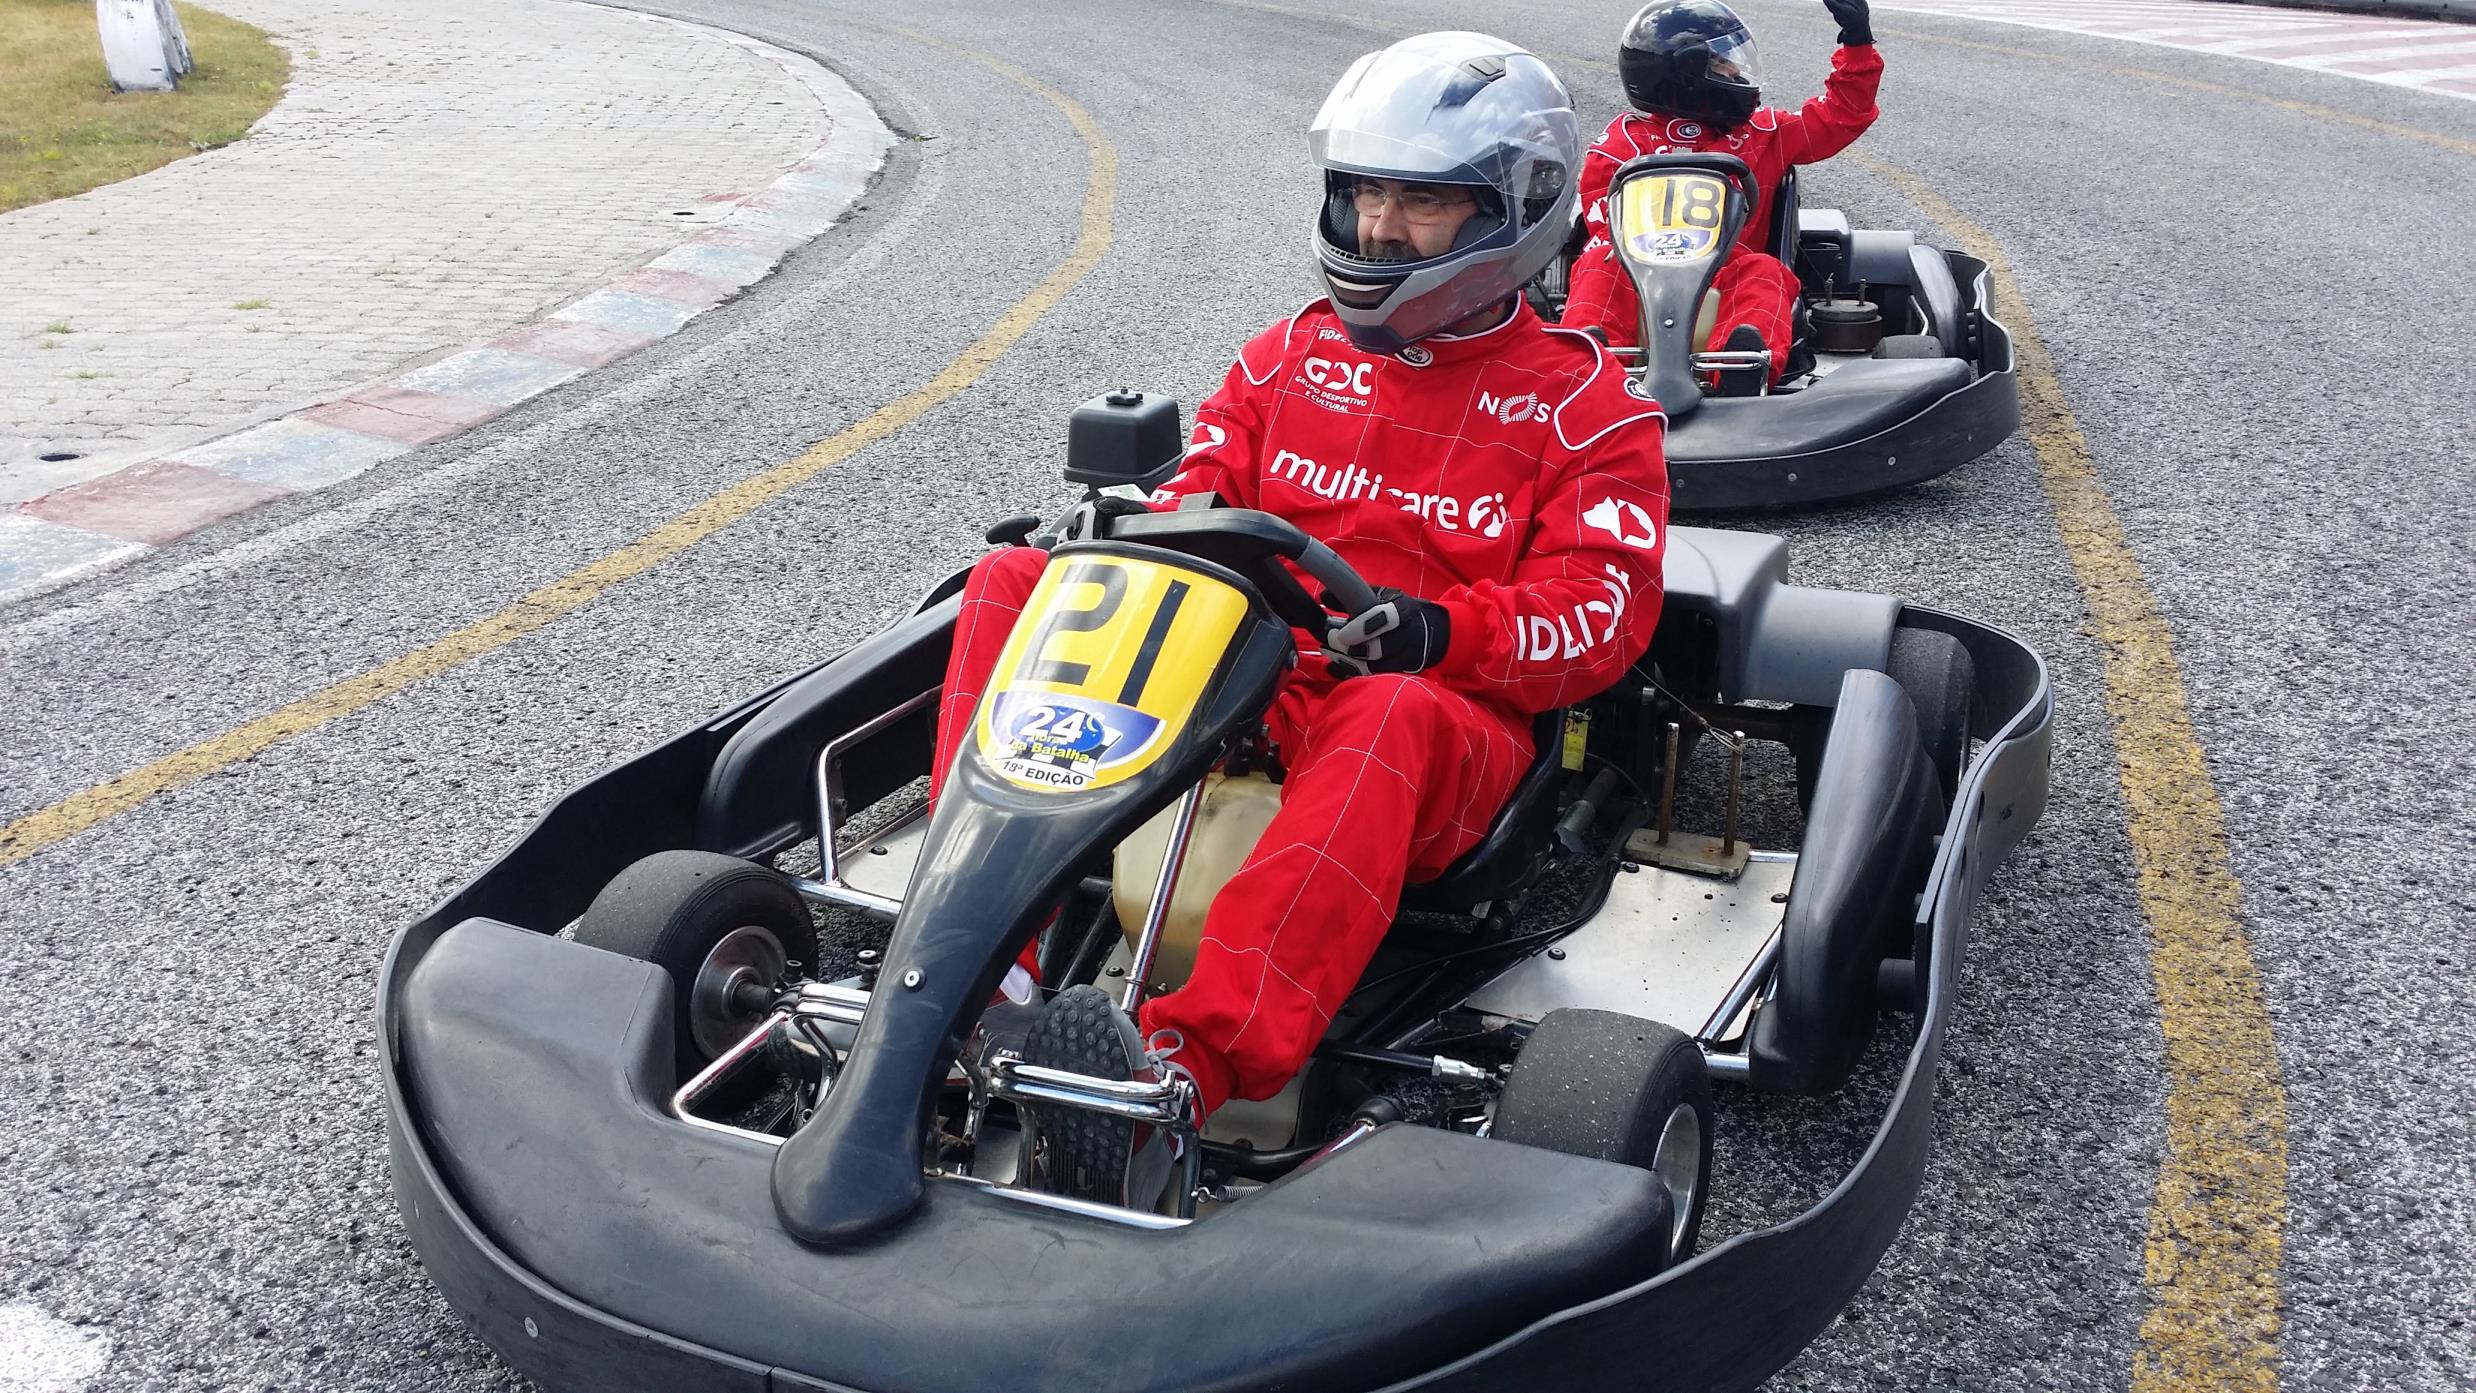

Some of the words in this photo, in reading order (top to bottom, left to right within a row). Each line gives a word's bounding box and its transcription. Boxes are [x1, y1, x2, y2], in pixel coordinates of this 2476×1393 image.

[1662, 179, 1720, 228] 18
[1294, 375, 1321, 394] GRUPO
[1320, 391, 1368, 407] DESPORTIVO
[1310, 393, 1350, 413] CULTURAL
[1477, 391, 1551, 425] NOS
[1012, 563, 1191, 708] 21
[1018, 706, 1084, 743] 24
[1031, 742, 1090, 763] Batalha
[1025, 767, 1084, 785] EDIÇÃO
